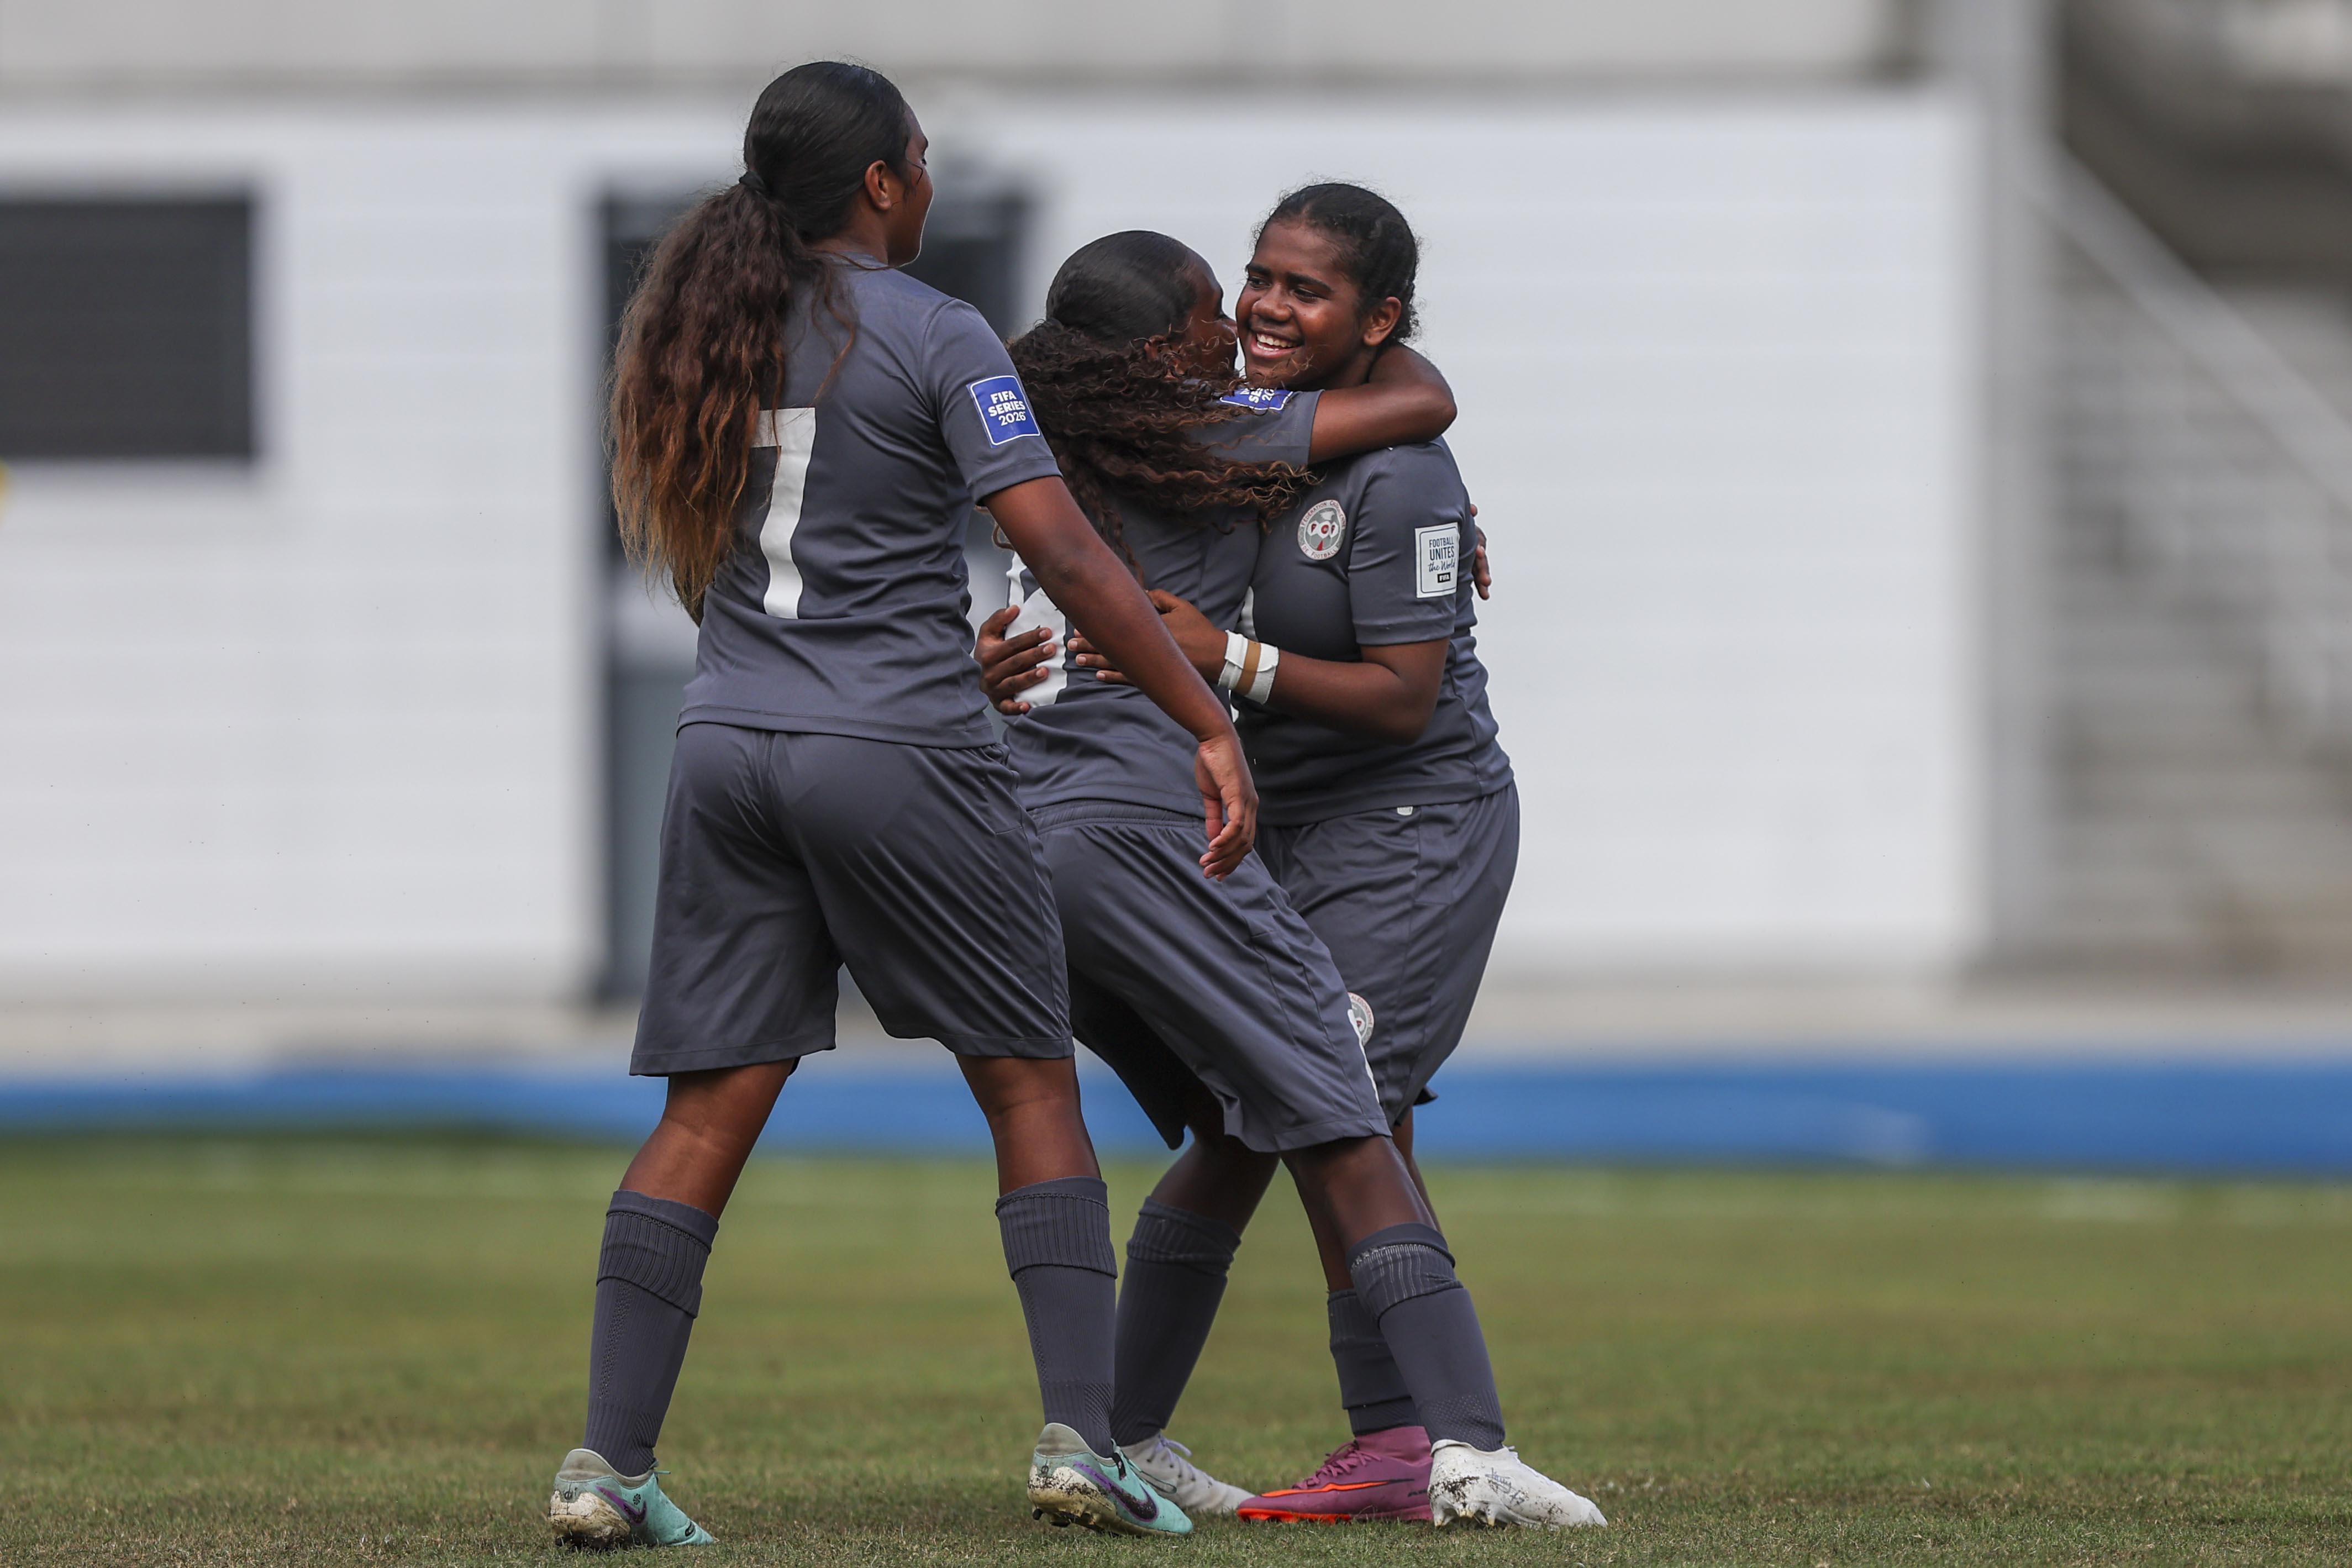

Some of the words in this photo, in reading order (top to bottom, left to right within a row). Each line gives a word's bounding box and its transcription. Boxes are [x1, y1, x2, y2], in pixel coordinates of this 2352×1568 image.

[990, 391, 1017, 404] FIFA
[988, 401, 1025, 417] SERIES
[998, 411, 1026, 426] 2026
[750, 407, 816, 619] 7
[1429, 536, 1454, 548] FOOTBALL
[1311, 548, 1338, 559] FOOTBALL
[1429, 546, 1455, 561] UNITES
[1428, 562, 1440, 572] the
[1441, 558, 1456, 571] World
